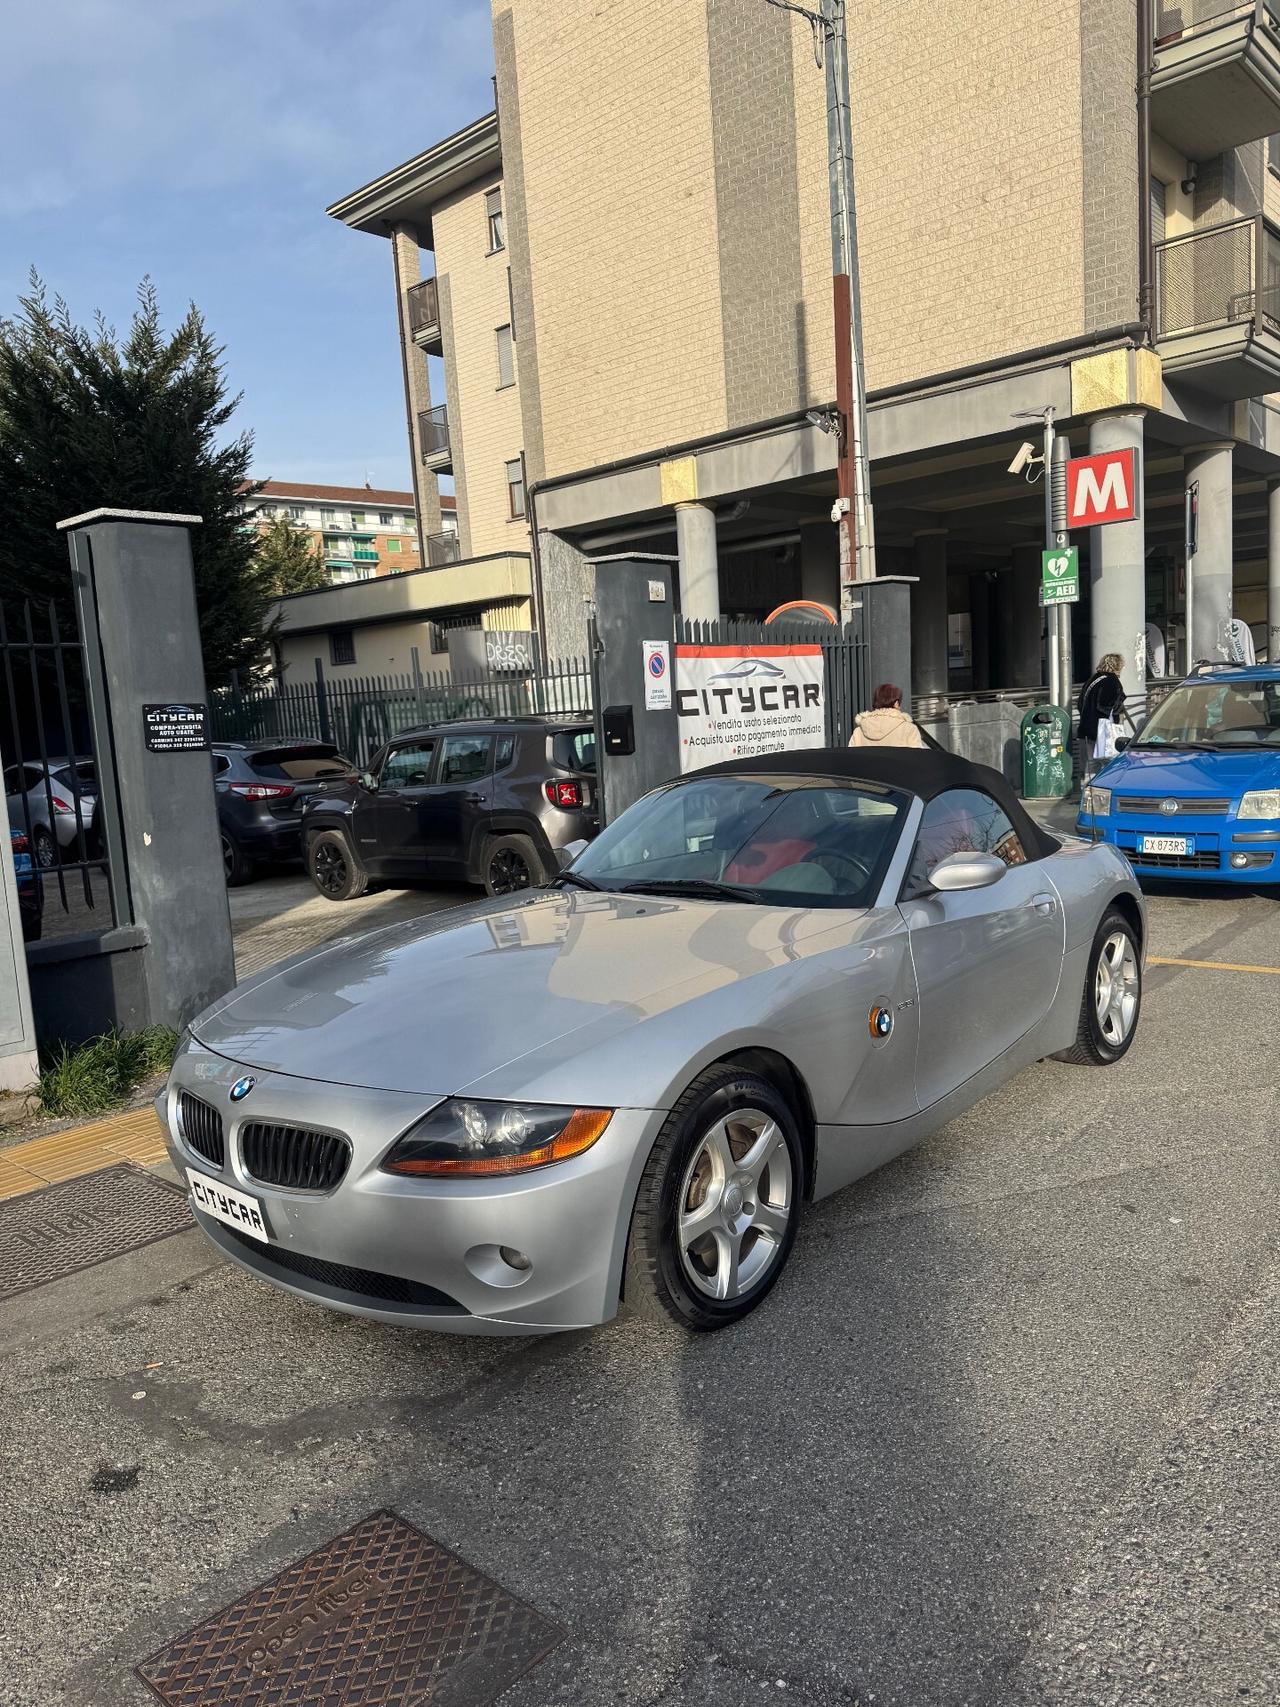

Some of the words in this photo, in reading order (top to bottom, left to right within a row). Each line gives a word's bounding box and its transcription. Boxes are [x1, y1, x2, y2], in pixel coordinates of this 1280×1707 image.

[1073, 462, 1129, 517] M
[1056, 585, 1076, 597] AED
[676, 683, 821, 717] CITYCAR
[147, 713, 203, 721] CITYCAR
[711, 718, 742, 730] Vendita
[744, 717, 761, 728] usato
[763, 714, 802, 726] selezionato
[689, 735, 724, 747] Acquisto
[725, 733, 745, 743] usato
[748, 729, 787, 742] pagamento
[788, 725, 821, 737] immediato
[737, 744, 755, 755] Ritiro
[757, 742, 785, 754] permute
[1144, 840, 1155, 851] CX
[1157, 840, 1186, 852] 873RS
[193, 1181, 263, 1232] CITYCAR
